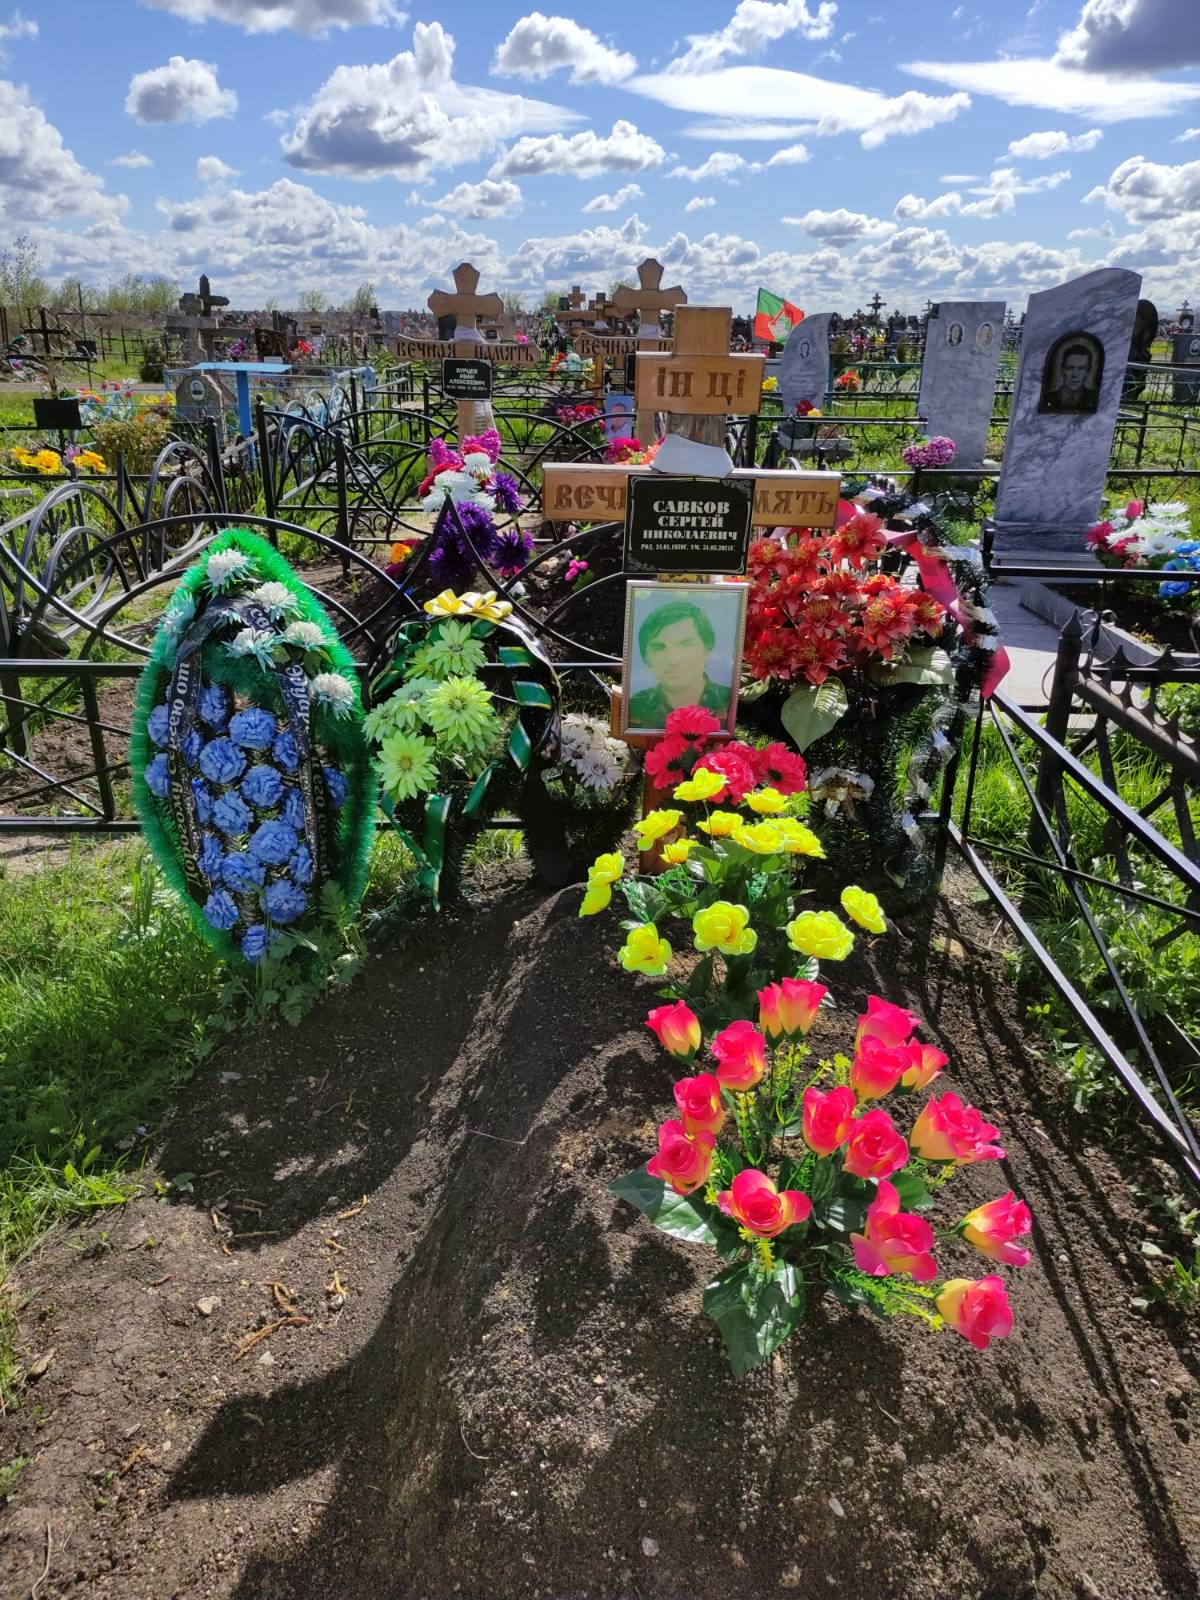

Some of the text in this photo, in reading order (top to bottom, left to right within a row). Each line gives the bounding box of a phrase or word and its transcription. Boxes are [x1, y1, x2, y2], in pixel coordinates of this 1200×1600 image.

[397, 342, 534, 361] ВЕЧНАЯ ПАМЯТЬ
[581, 339, 640, 355] ВЕЧНАЯ
[553, 484, 834, 514] ВЕЧ МЯТЬ
[652, 500, 730, 514] САВКОВ
[658, 513, 724, 528] СЕРГЕЙ
[643, 529, 738, 541] НИКОЛАЕВИЧ
[176, 662, 191, 696] от
[313, 774, 327, 808] его
